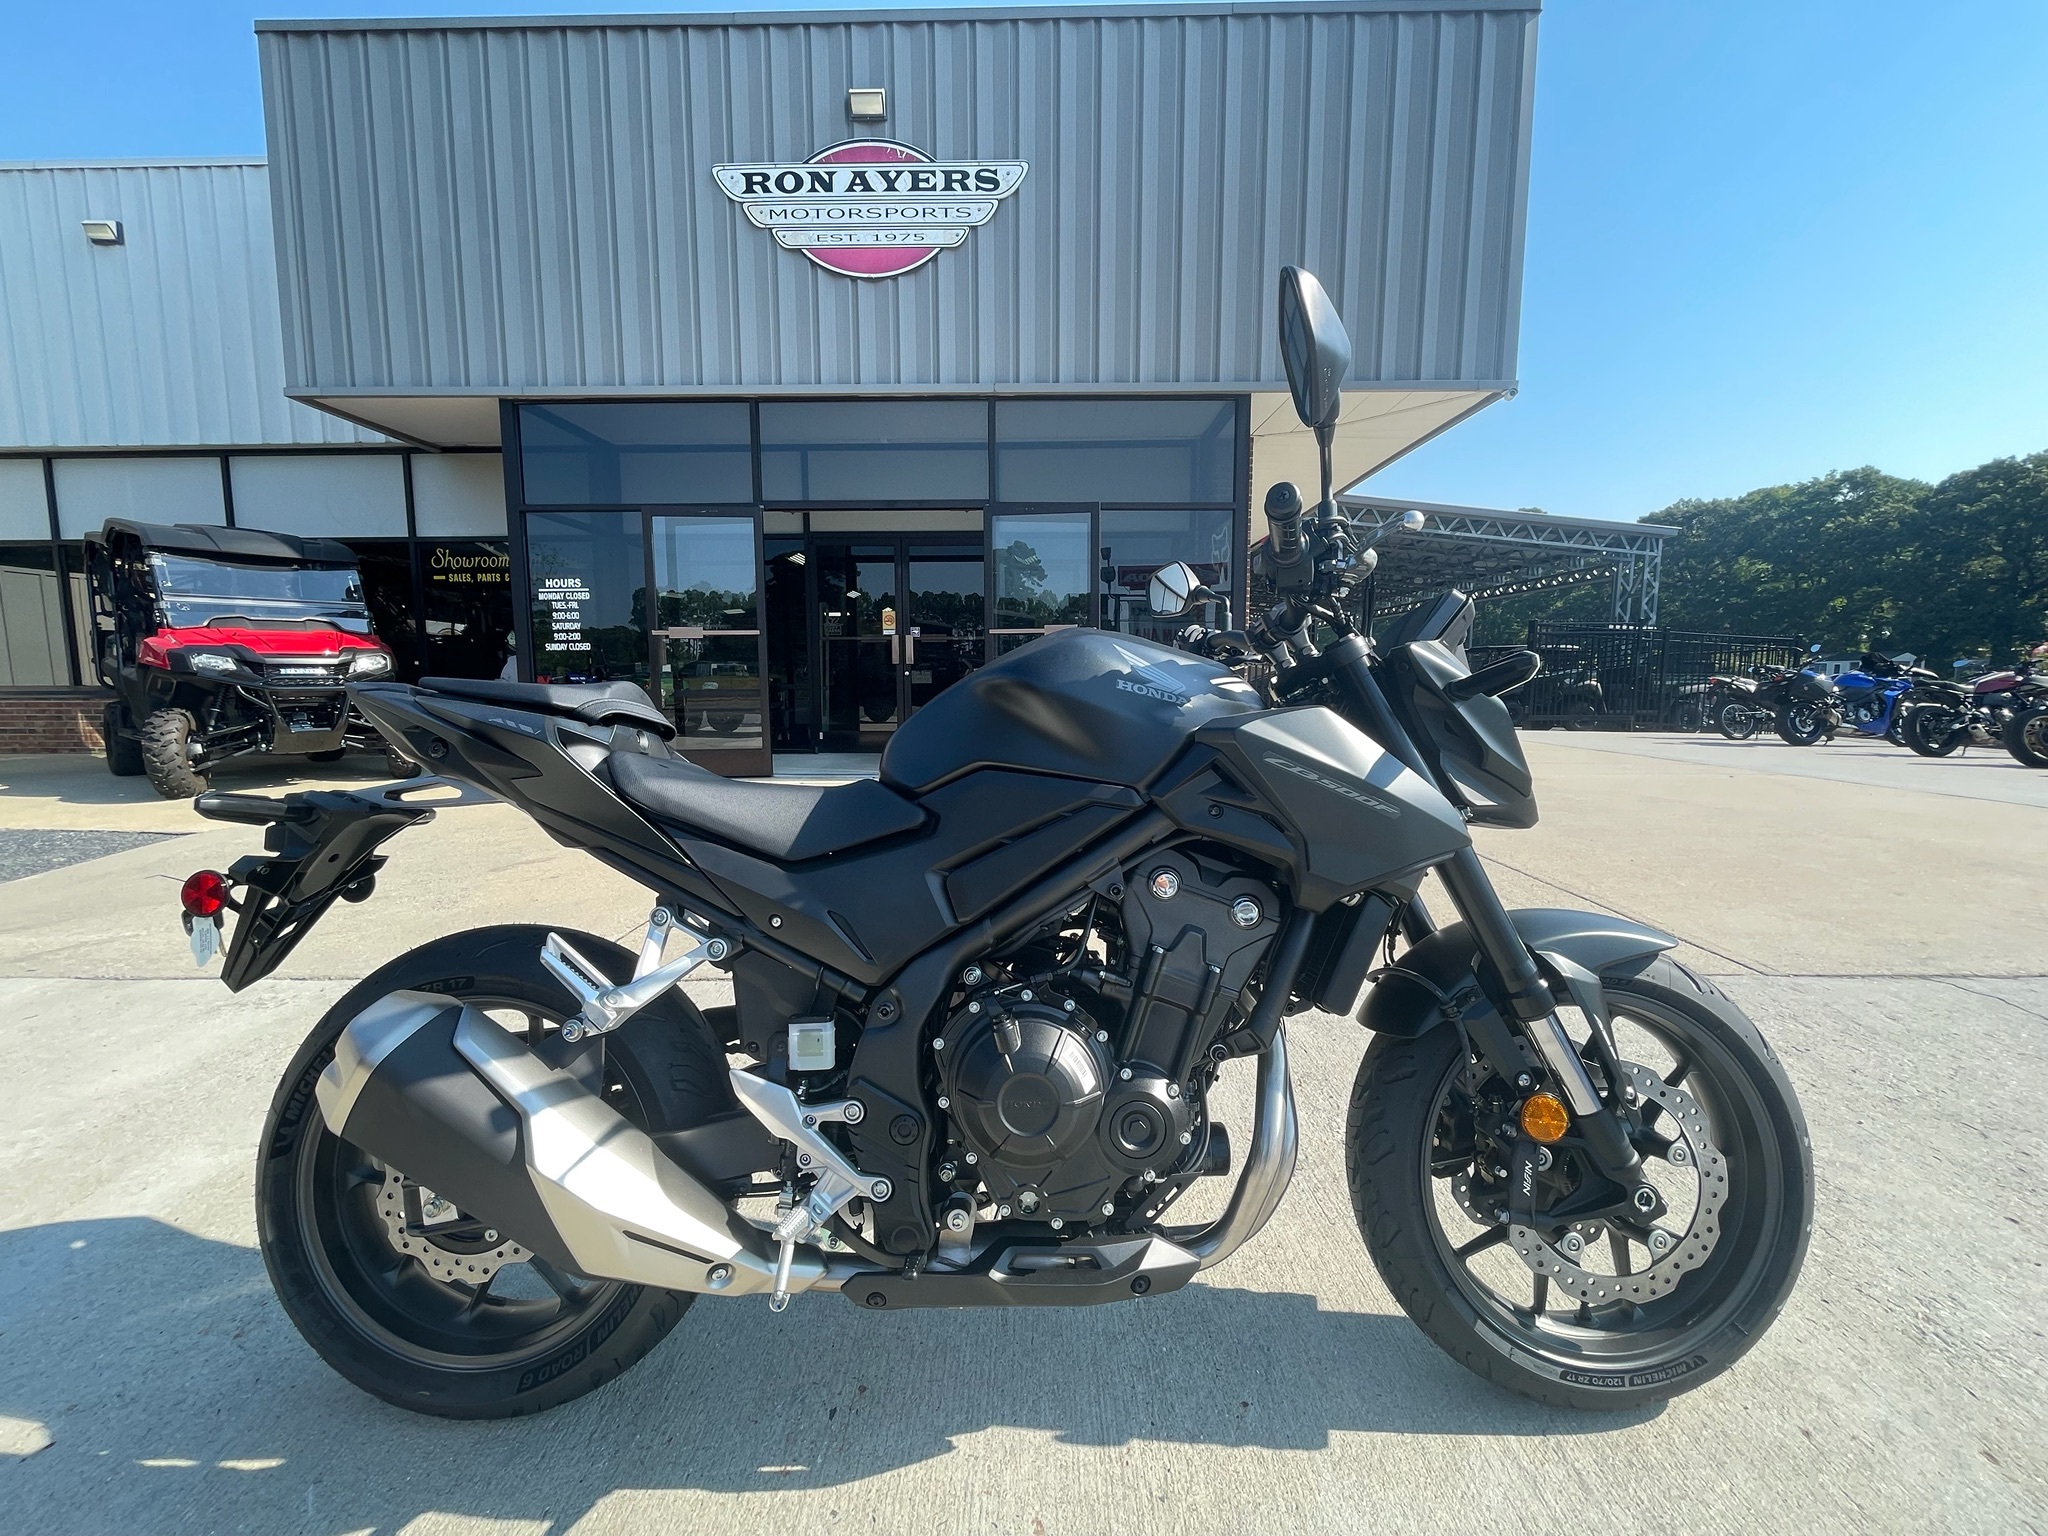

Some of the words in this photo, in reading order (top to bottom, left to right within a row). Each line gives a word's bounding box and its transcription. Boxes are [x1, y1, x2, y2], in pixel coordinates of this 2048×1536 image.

[740, 171, 838, 195] RON
[844, 168, 1001, 194] AYERS
[768, 205, 972, 220] MOTORSPORTS
[816, 233, 861, 242] EST.
[873, 232, 925, 242] 1975
[431, 548, 510, 570] Showroom
[448, 573, 474, 583] SALES,
[477, 573, 501, 582] PARTS
[545, 578, 582, 588] HOURS
[538, 592, 565, 600] MONDAY
[565, 592, 590, 600] CLOSED
[552, 611, 580, 620] 9:00-6:00
[551, 622, 581, 630] SATURDAY
[545, 643, 568, 651] SUNDAY
[568, 642, 591, 651] CLOSED
[1115, 679, 1188, 705] HONDA
[448, 978, 467, 988] 17
[538, 1343, 585, 1381] ROAD
[1565, 1373, 1577, 1382] 17
[1577, 1375, 1590, 1383] ZR
[1632, 1363, 1687, 1386] MICHELIN
[521, 1372, 534, 1388] 6
[1592, 1377, 1623, 1387] 120/70
